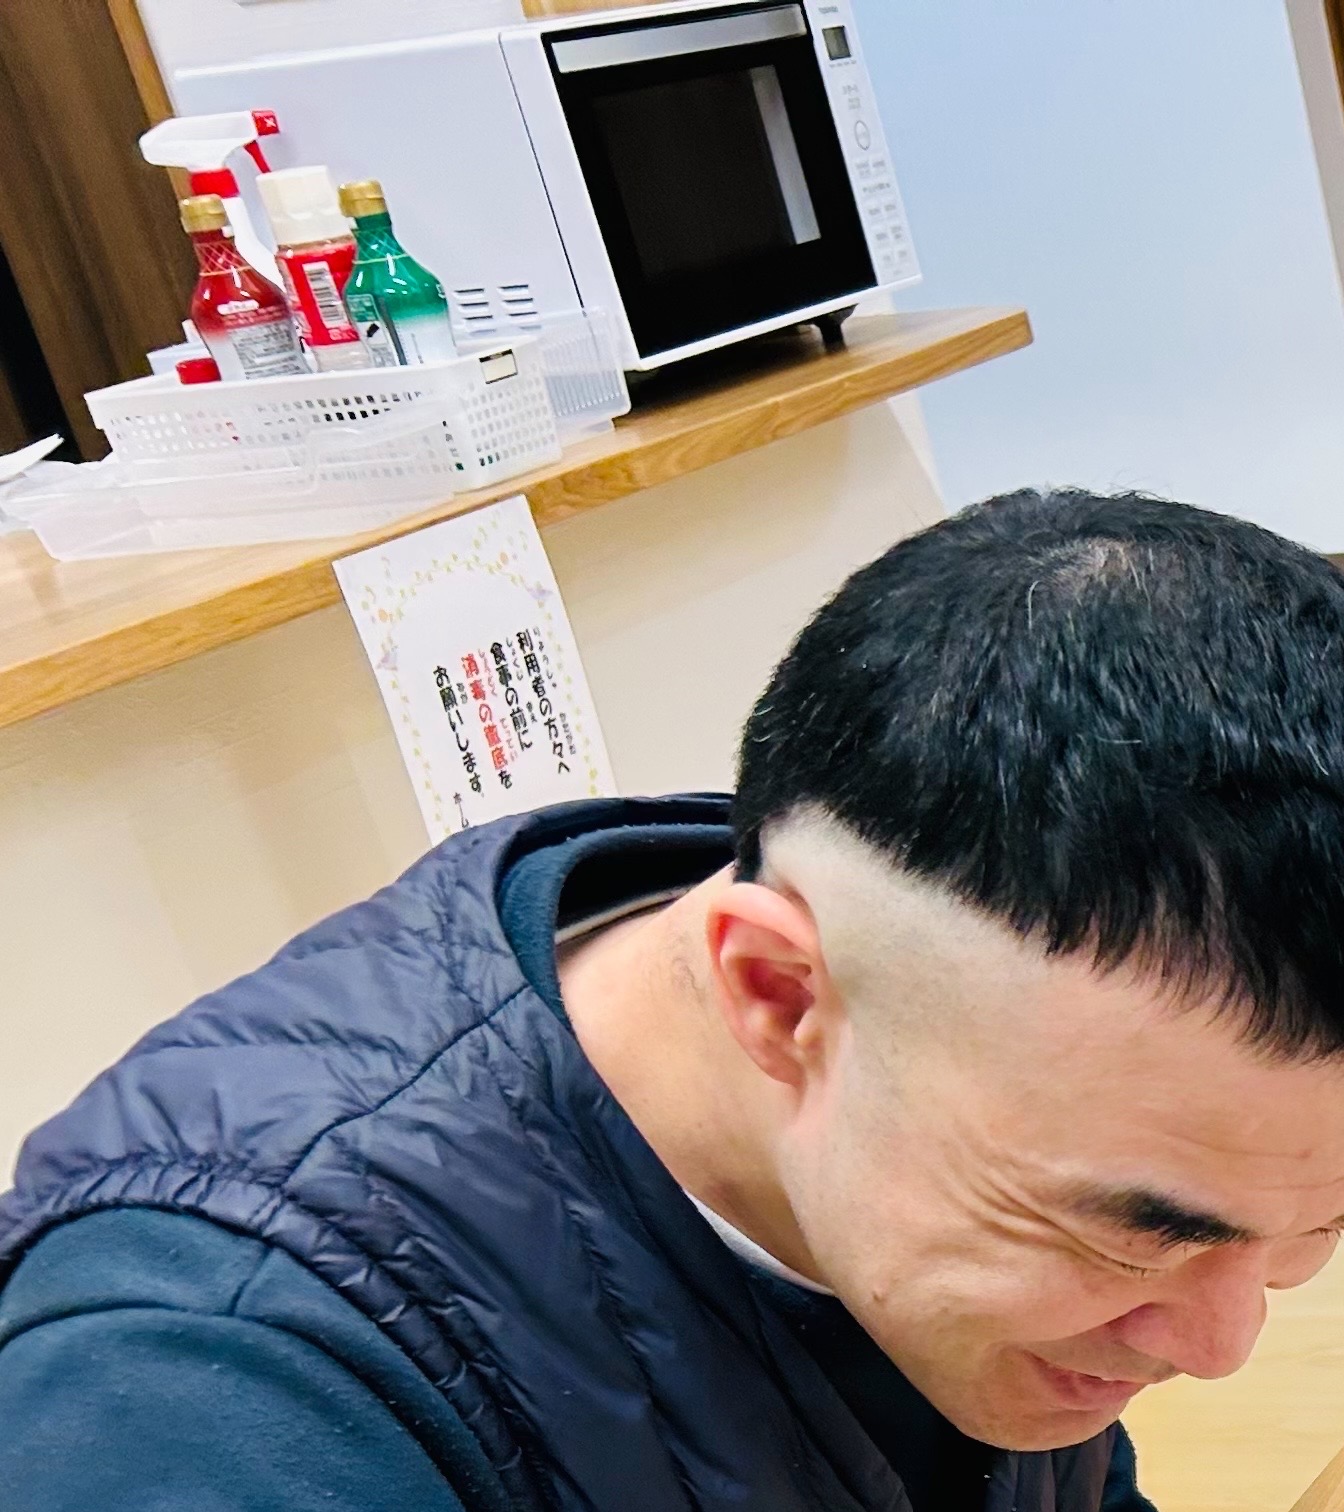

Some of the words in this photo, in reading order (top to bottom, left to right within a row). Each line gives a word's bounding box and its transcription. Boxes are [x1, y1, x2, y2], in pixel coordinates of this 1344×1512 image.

[461, 653, 512, 789] 消毒の徹底を
[490, 642, 533, 751] 食事の前に
[516, 628, 570, 774] 利用者の方々へ
